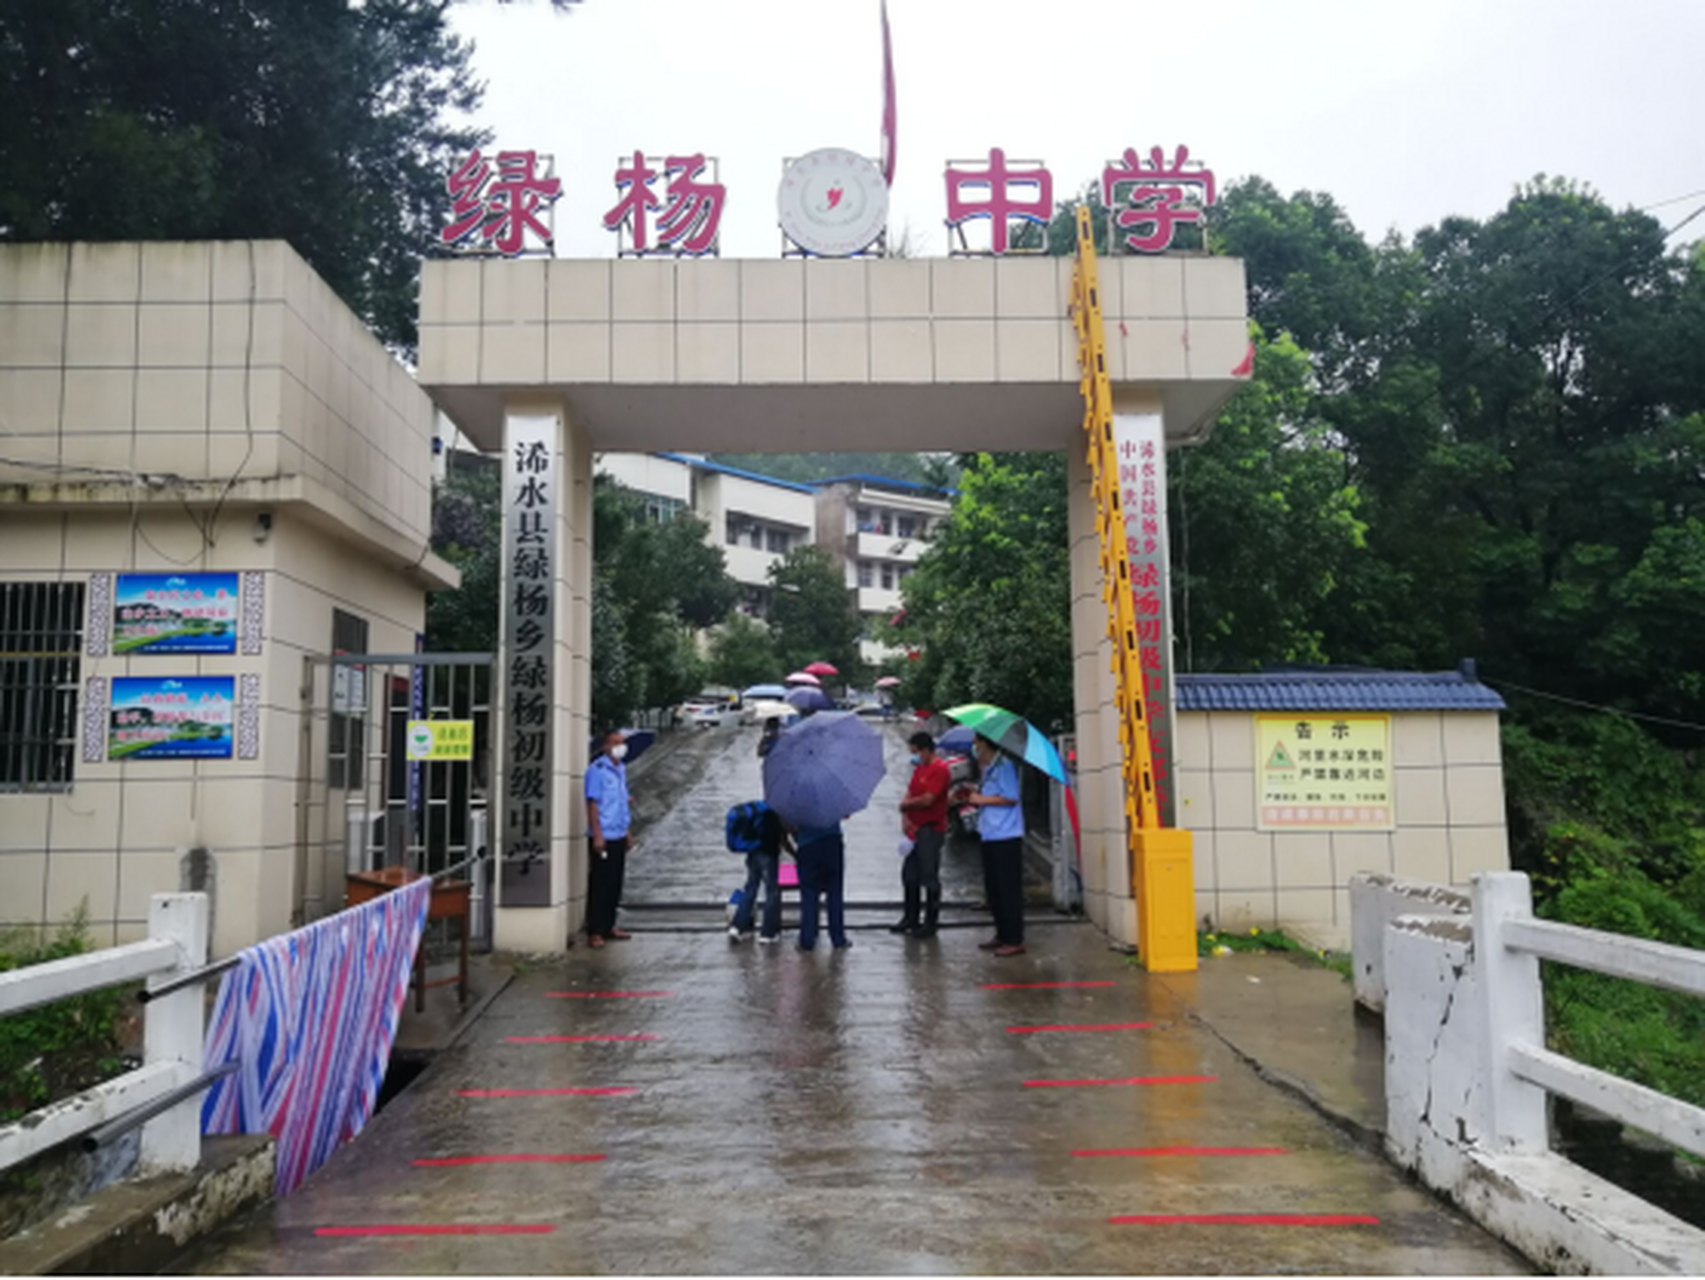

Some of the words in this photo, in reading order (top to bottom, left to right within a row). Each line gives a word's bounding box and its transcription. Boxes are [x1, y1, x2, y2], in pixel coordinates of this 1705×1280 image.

[441, 147, 728, 254] 绿杨
[944, 144, 1216, 253] 中学
[508, 440, 550, 877] 浠水县绿杨乡绿杨初级中学
